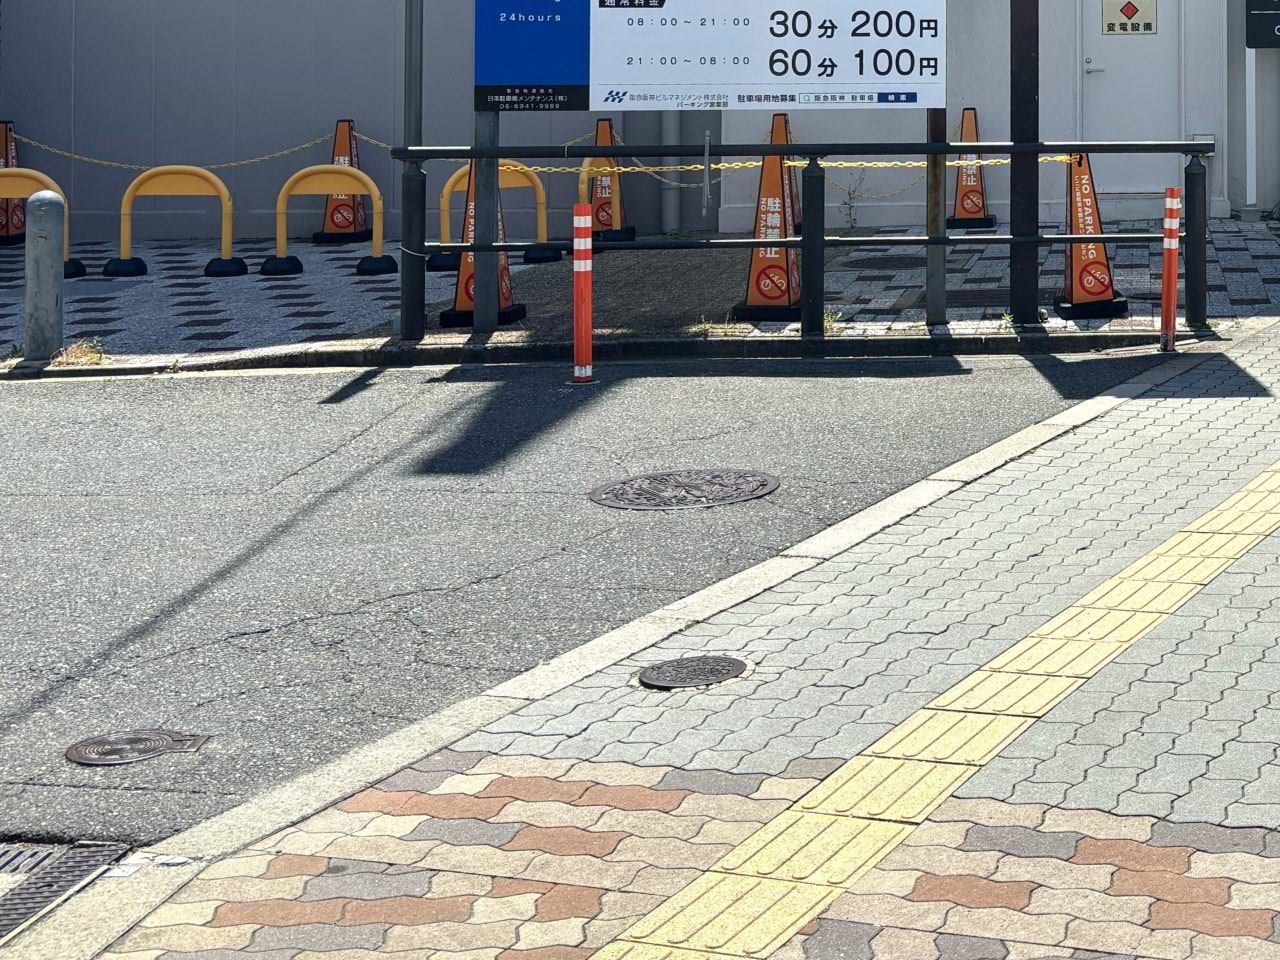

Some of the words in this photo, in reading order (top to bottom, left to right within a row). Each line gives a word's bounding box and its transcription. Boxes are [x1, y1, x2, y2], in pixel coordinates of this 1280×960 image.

[500, 13, 561, 21] 24hours
[769, 10, 838, 38] 30分
[851, 10, 938, 38] 200円
[1106, 22, 1153, 32] 変電設備
[769, 49, 838, 77] 60分
[854, 49, 938, 76] 100円
[1081, 175, 1090, 194] NO
[761, 198, 767, 211] NO
[1083, 198, 1097, 259] PARKNG
